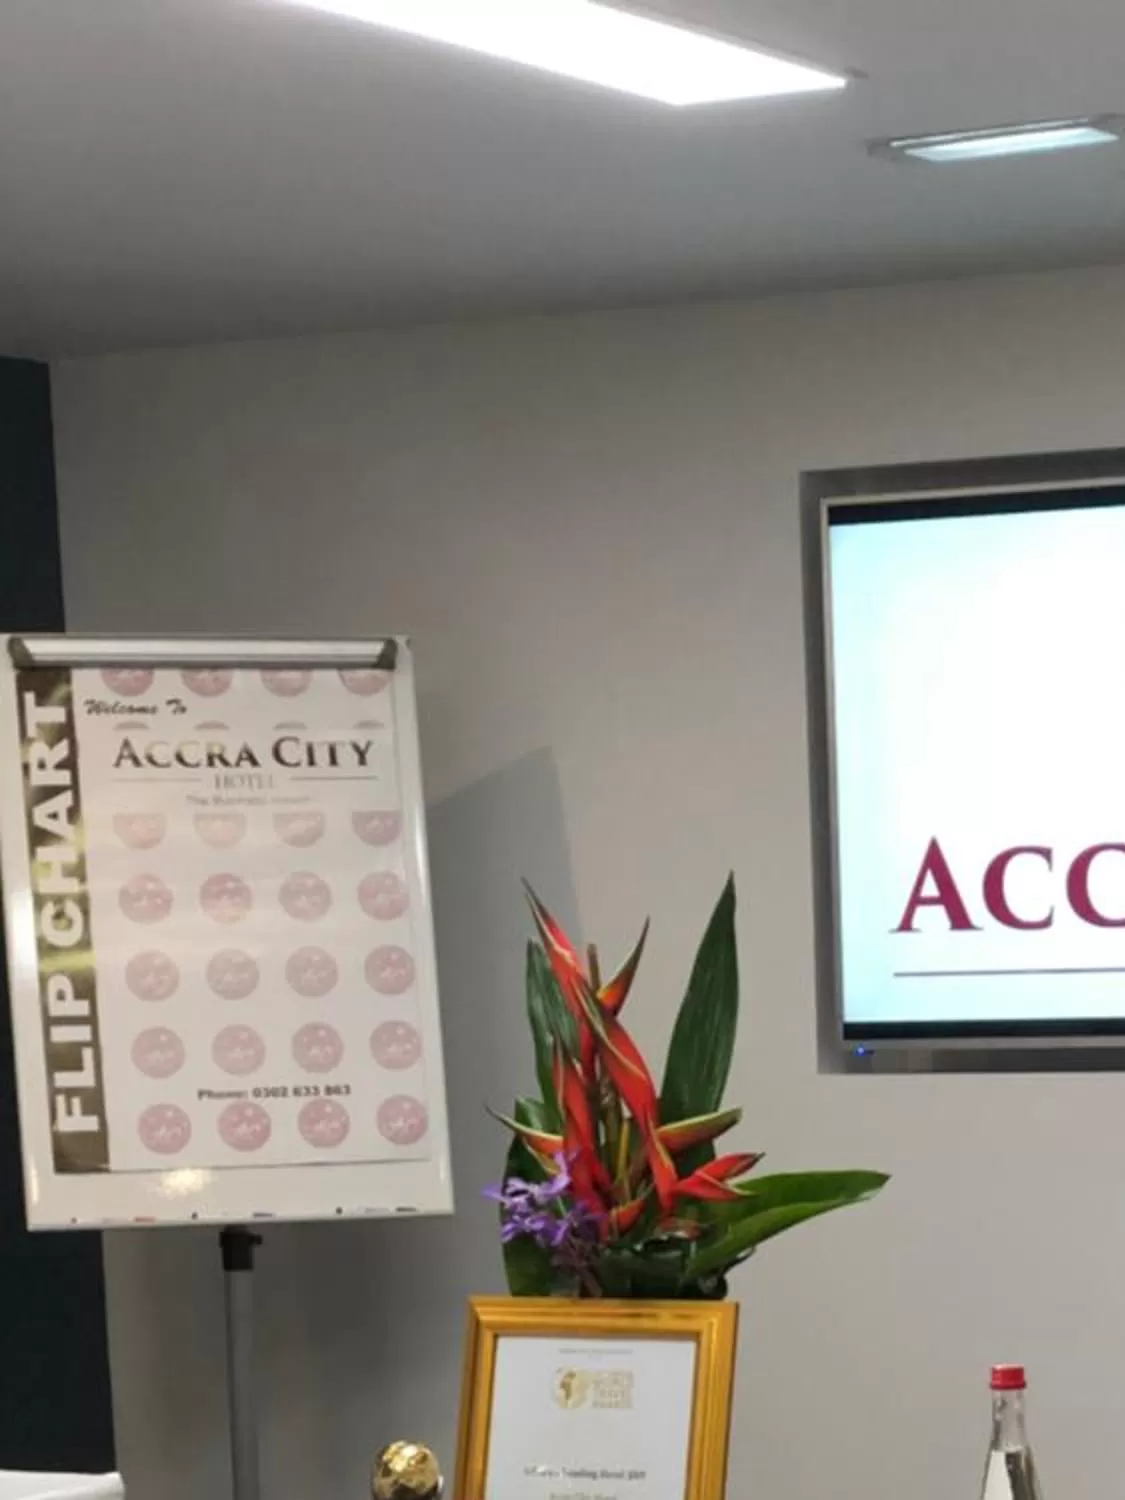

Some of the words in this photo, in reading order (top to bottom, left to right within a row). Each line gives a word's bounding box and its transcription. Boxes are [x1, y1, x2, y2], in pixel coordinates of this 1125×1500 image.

[112, 737, 262, 768] ACCRA
[271, 736, 374, 768] CITY
[166, 698, 188, 716] To
[24, 690, 87, 949] CHART
[48, 973, 99, 1133] FLIP
